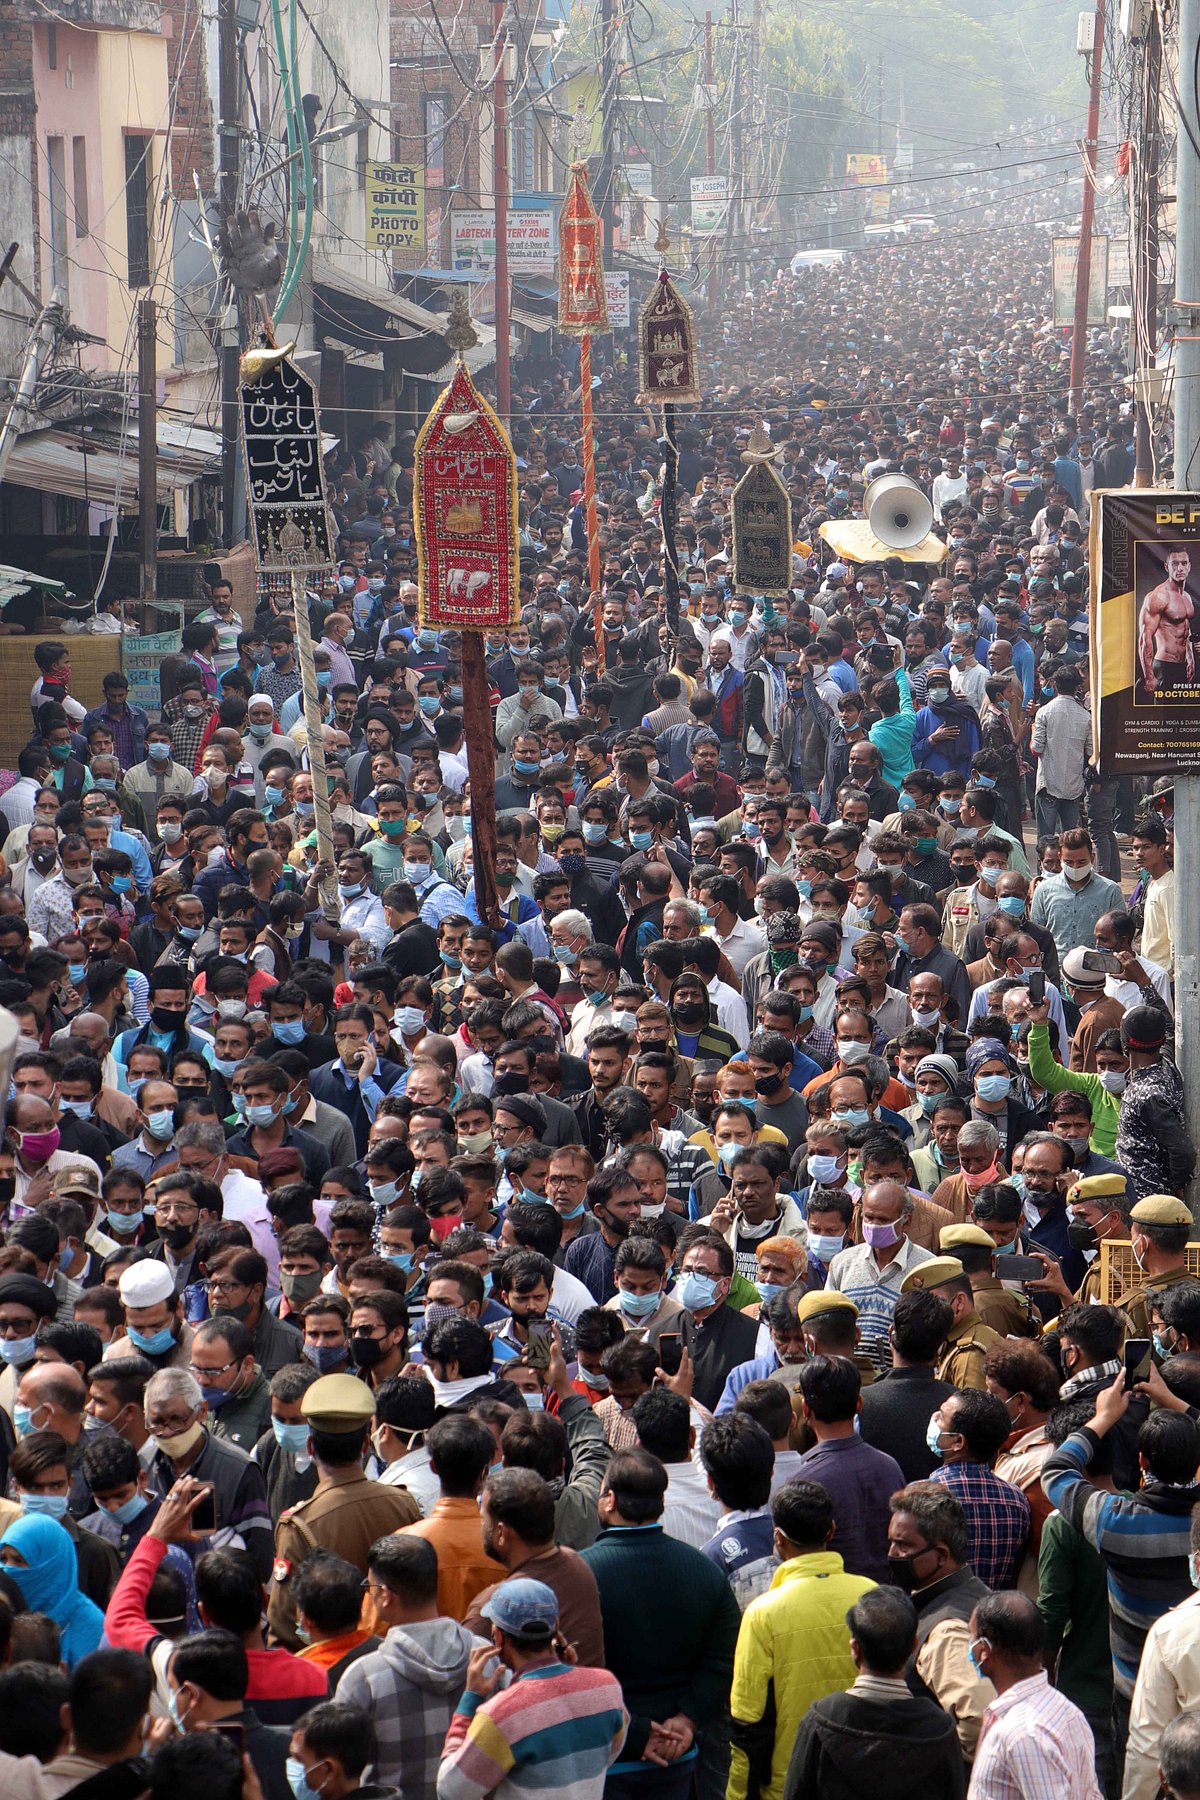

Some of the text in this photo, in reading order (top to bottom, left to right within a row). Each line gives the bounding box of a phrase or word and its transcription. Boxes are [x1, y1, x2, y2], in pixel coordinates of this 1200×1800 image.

[373, 166, 418, 184] फोटो
[701, 182, 725, 193] JOSEPH
[371, 188, 419, 205] कॉपी
[371, 217, 419, 231] PHOTO
[376, 233, 413, 246] COPY
[456, 228, 550, 238] LABTECH BTERY ZONE
[1156, 504, 1185, 523] BE
[1111, 502, 1129, 591] FITNESS
